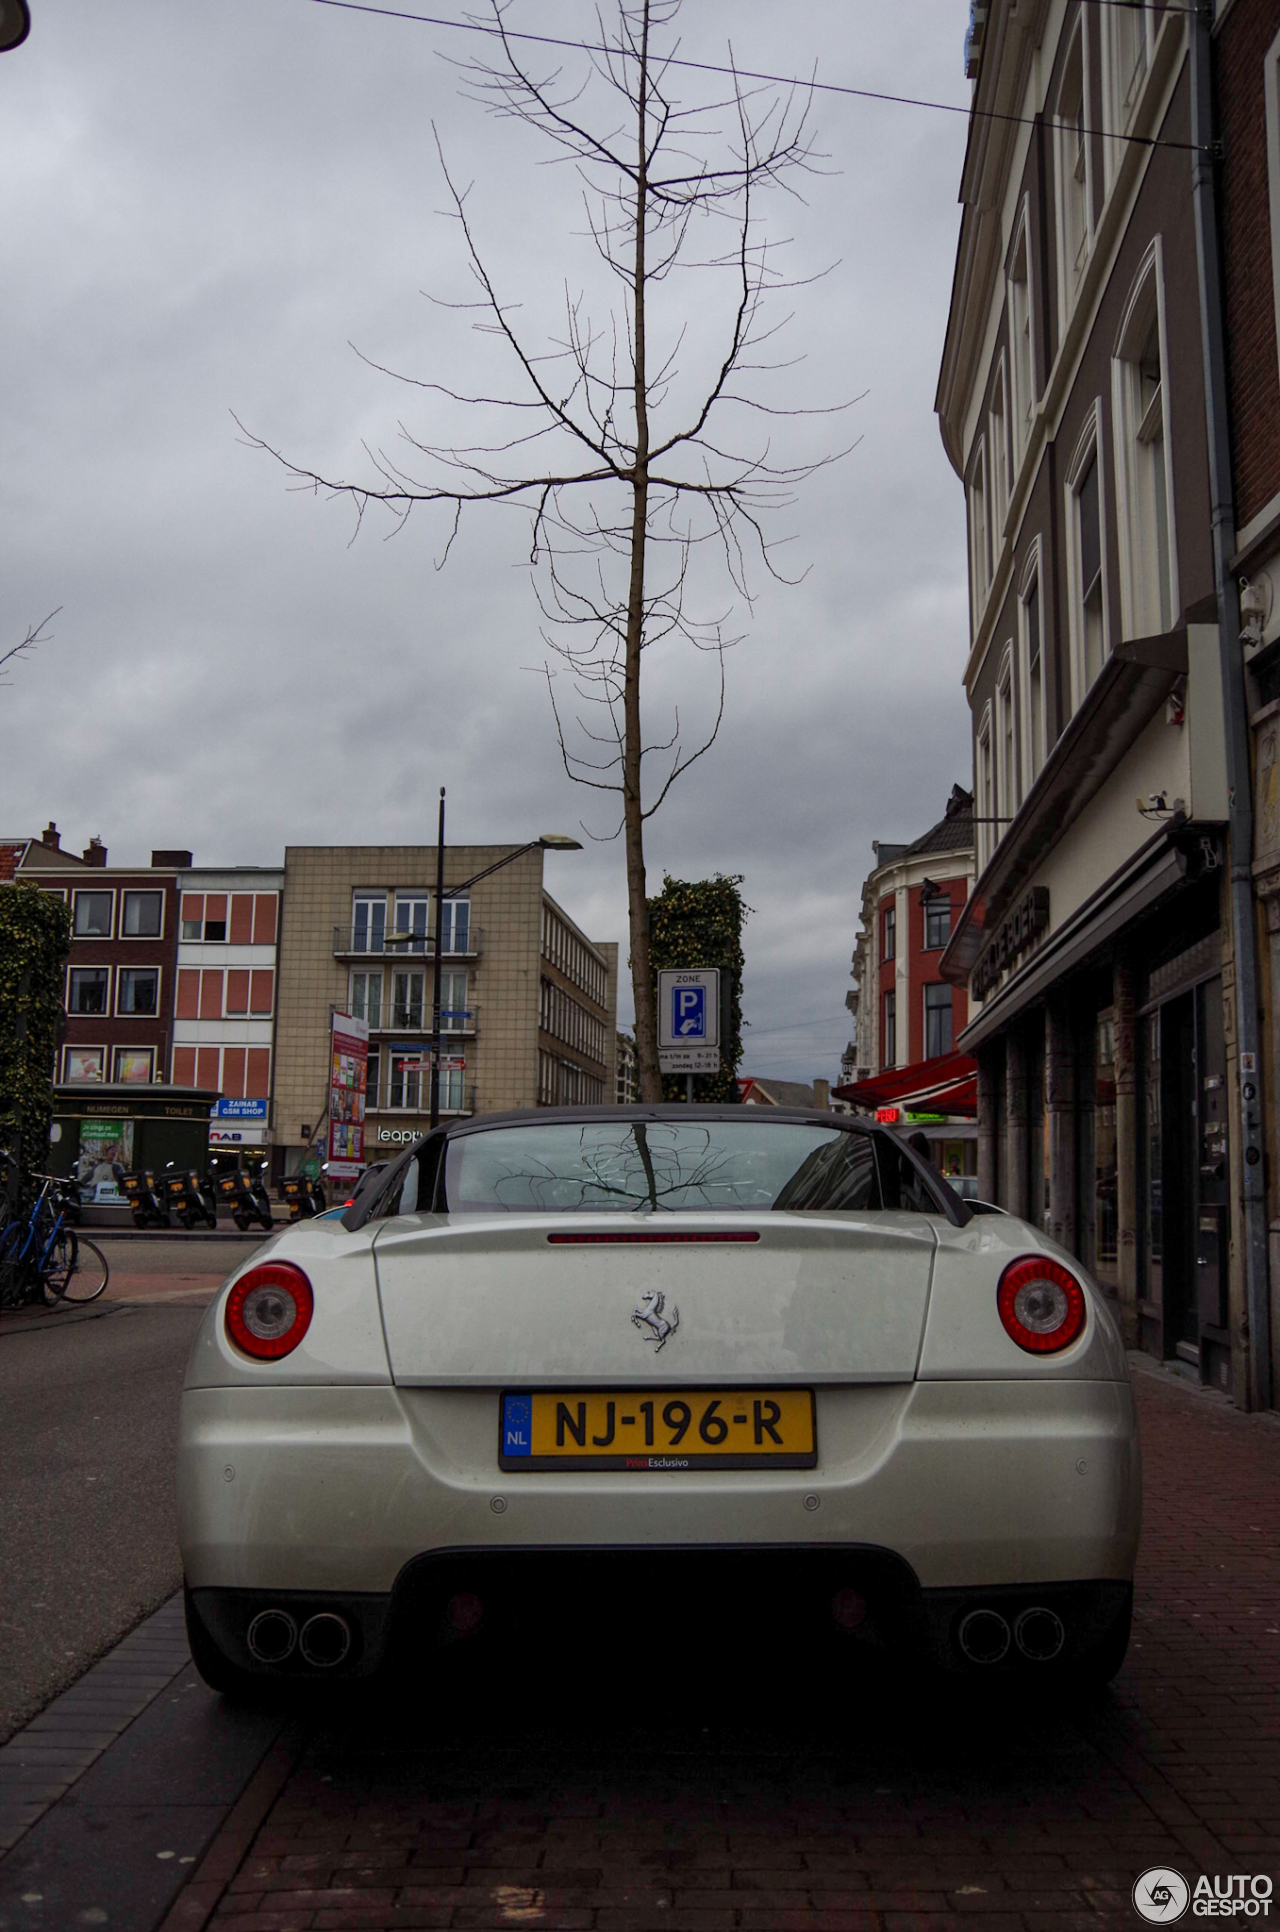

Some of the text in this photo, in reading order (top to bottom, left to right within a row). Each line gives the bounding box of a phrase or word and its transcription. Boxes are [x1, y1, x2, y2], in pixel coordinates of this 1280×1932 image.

[676, 975, 701, 983] ZONE
[679, 991, 698, 1017] P
[228, 1100, 258, 1108] ZAINAB
[86, 1105, 130, 1114] NIJMEGEN
[165, 1106, 194, 1116] TOILET
[556, 1400, 783, 1447] NJ-196-R
[507, 1432, 527, 1445] NL
